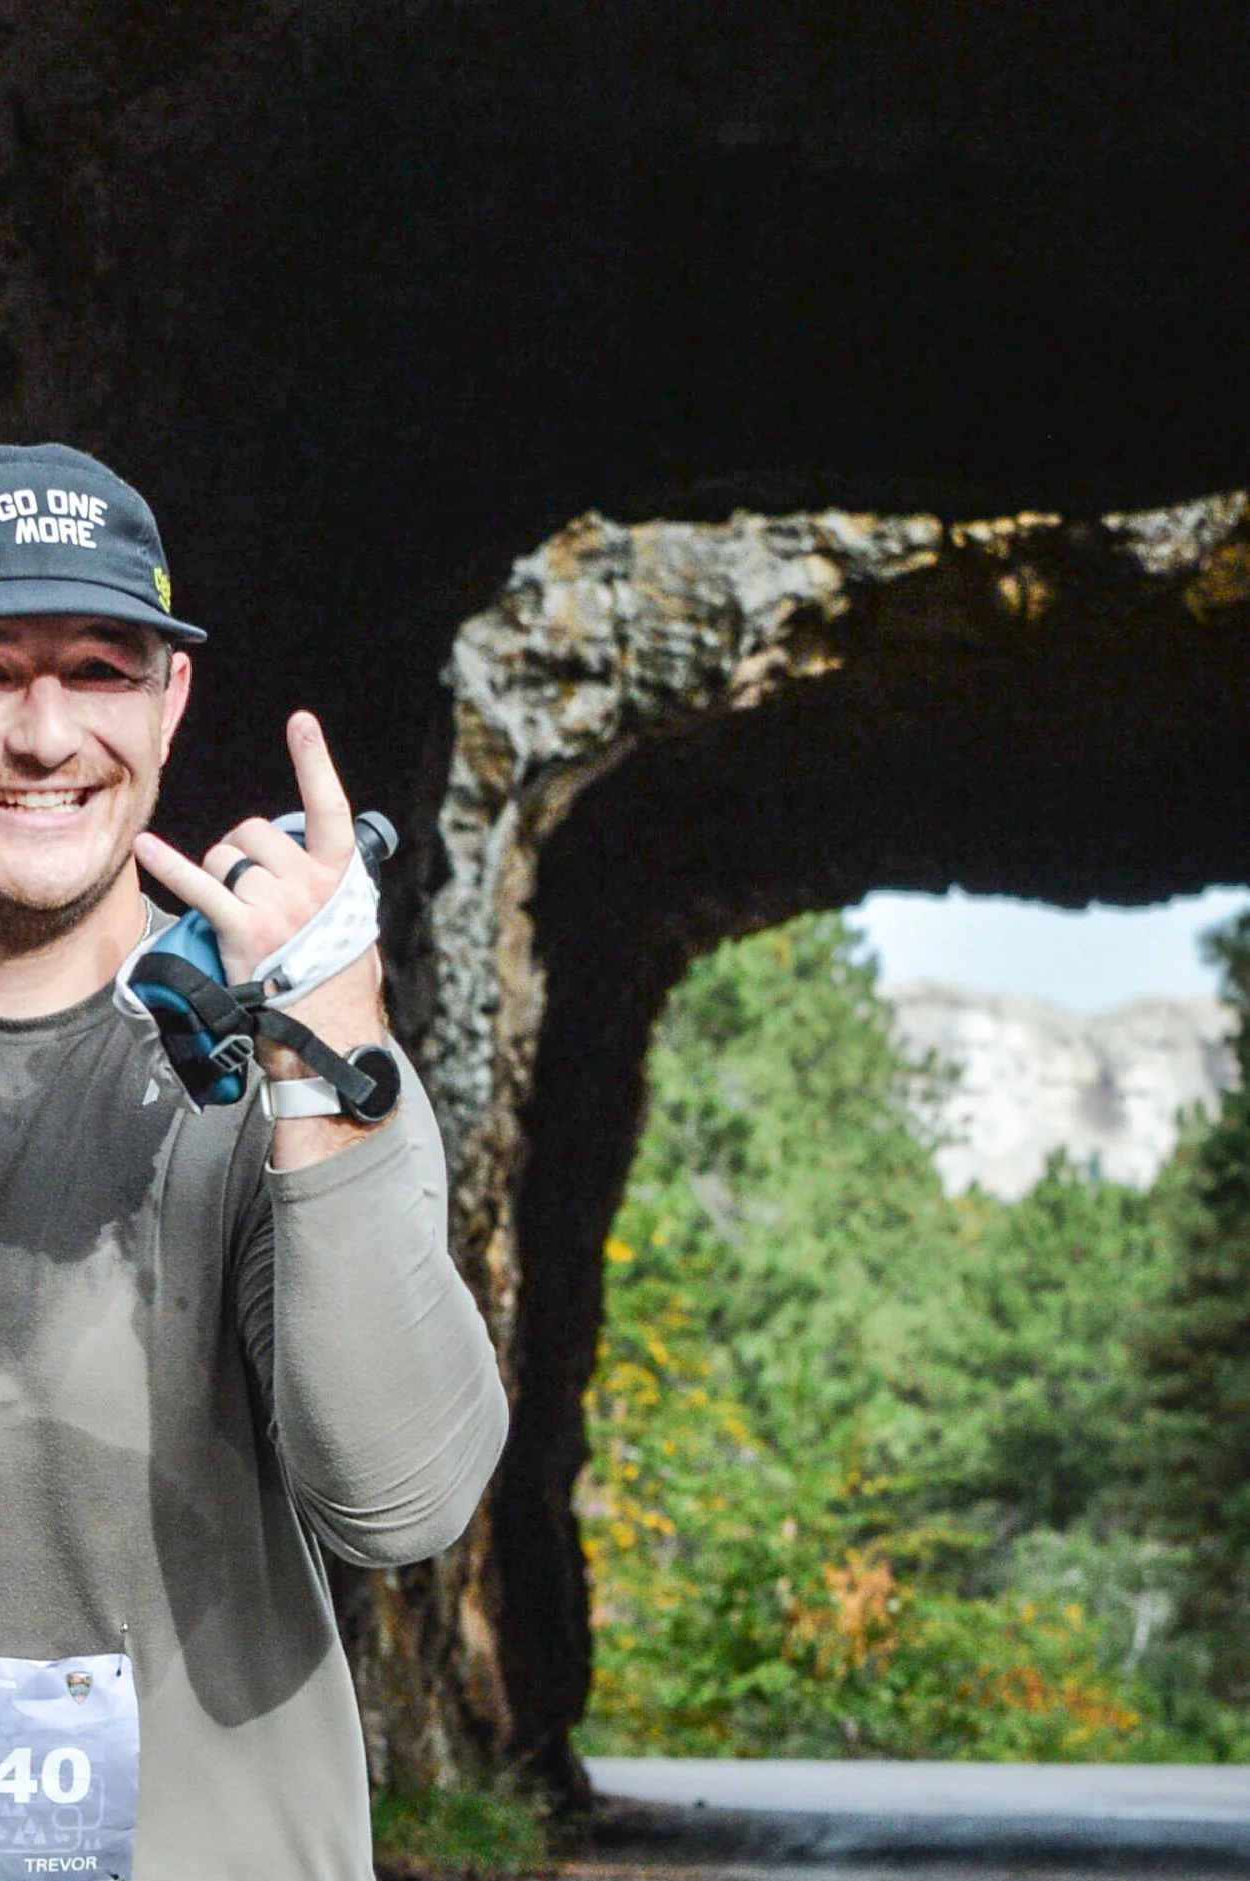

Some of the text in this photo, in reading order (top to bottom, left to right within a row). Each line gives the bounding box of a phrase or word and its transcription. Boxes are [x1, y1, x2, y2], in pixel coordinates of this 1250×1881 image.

[46, 488, 109, 528] ONE
[15, 516, 98, 549] MORE
[24, 1856, 98, 1873] TREVOR
